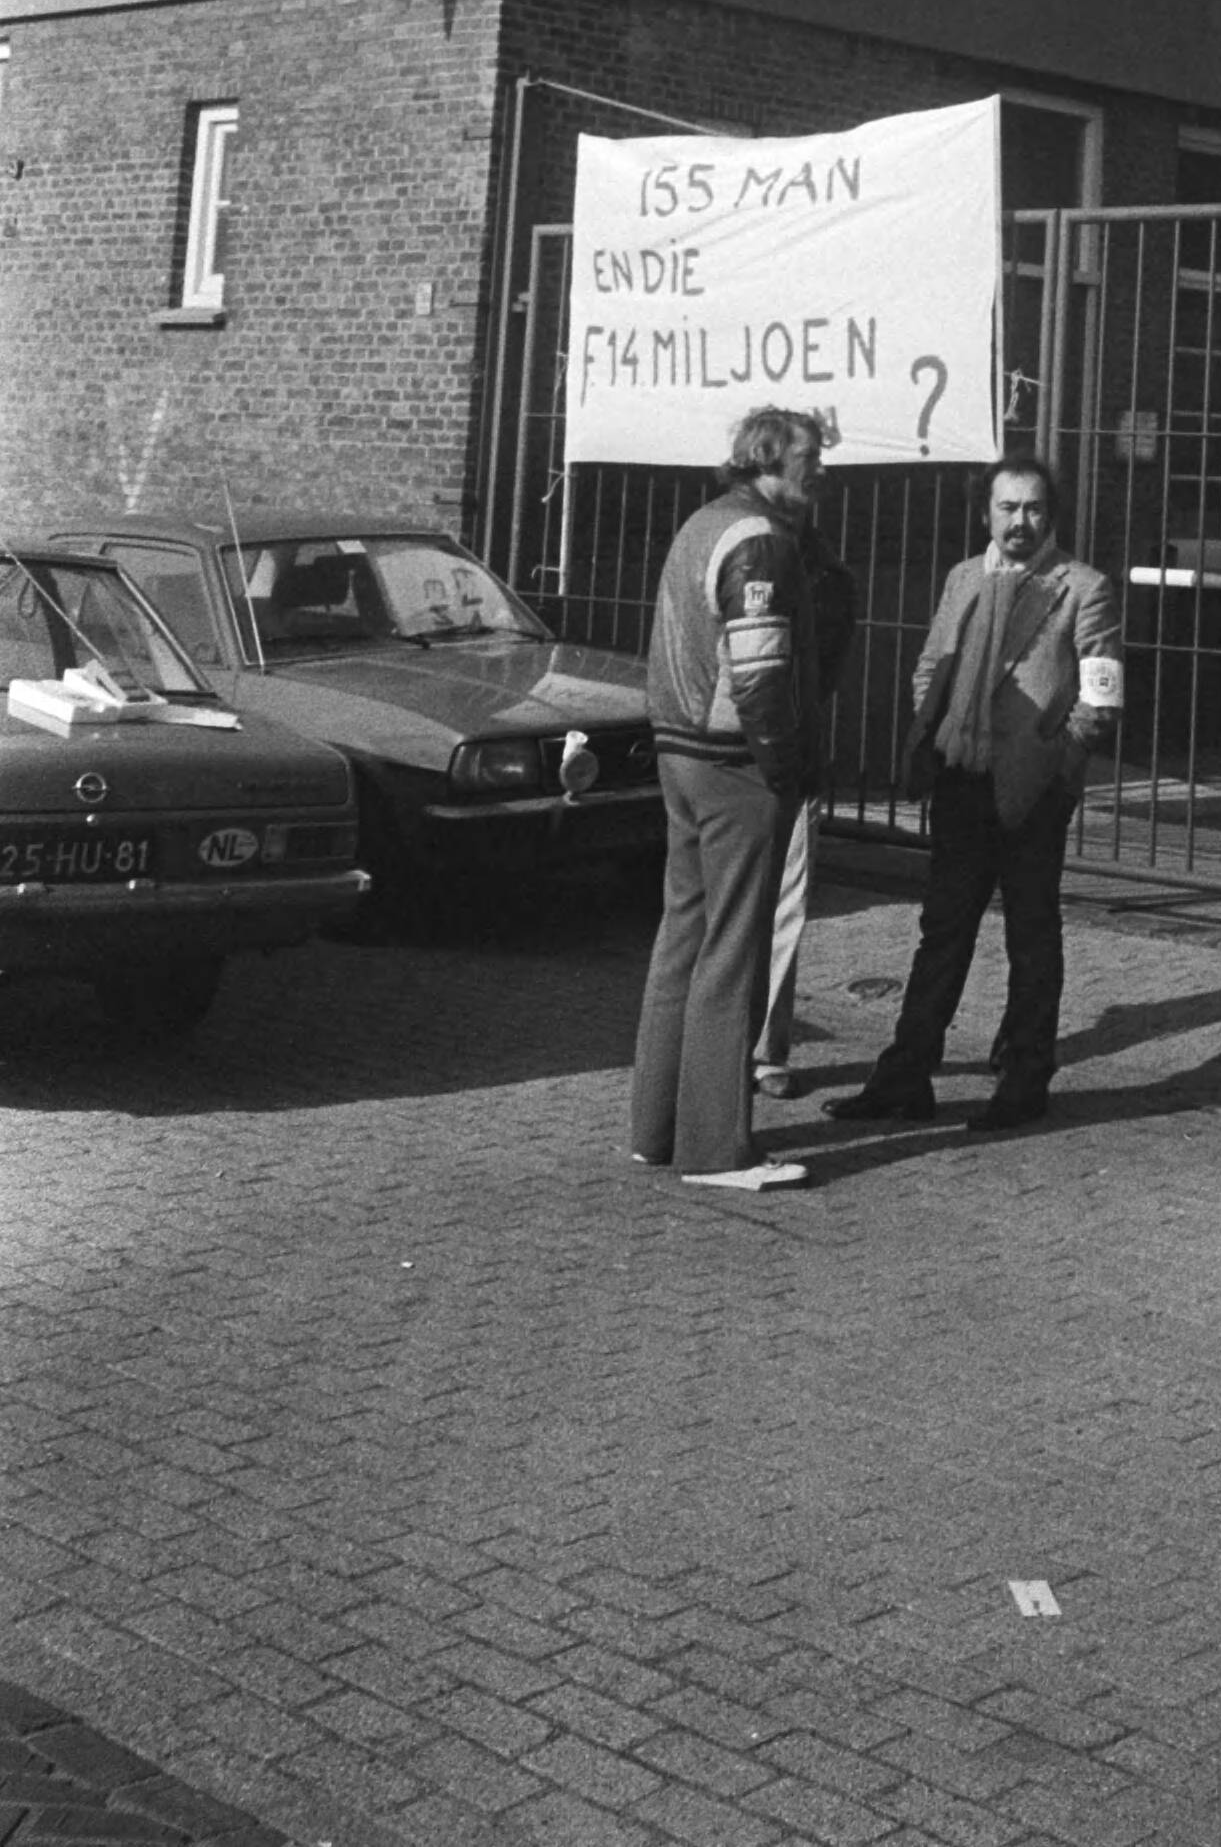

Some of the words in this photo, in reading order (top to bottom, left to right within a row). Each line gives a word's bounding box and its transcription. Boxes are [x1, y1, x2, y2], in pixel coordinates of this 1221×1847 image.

[639, 164, 715, 218] 155
[732, 155, 861, 209] MAN
[652, 315, 876, 389] MILJOEN
[0, 840, 149, 877] 25-HU-81
[208, 831, 247, 863] NL
